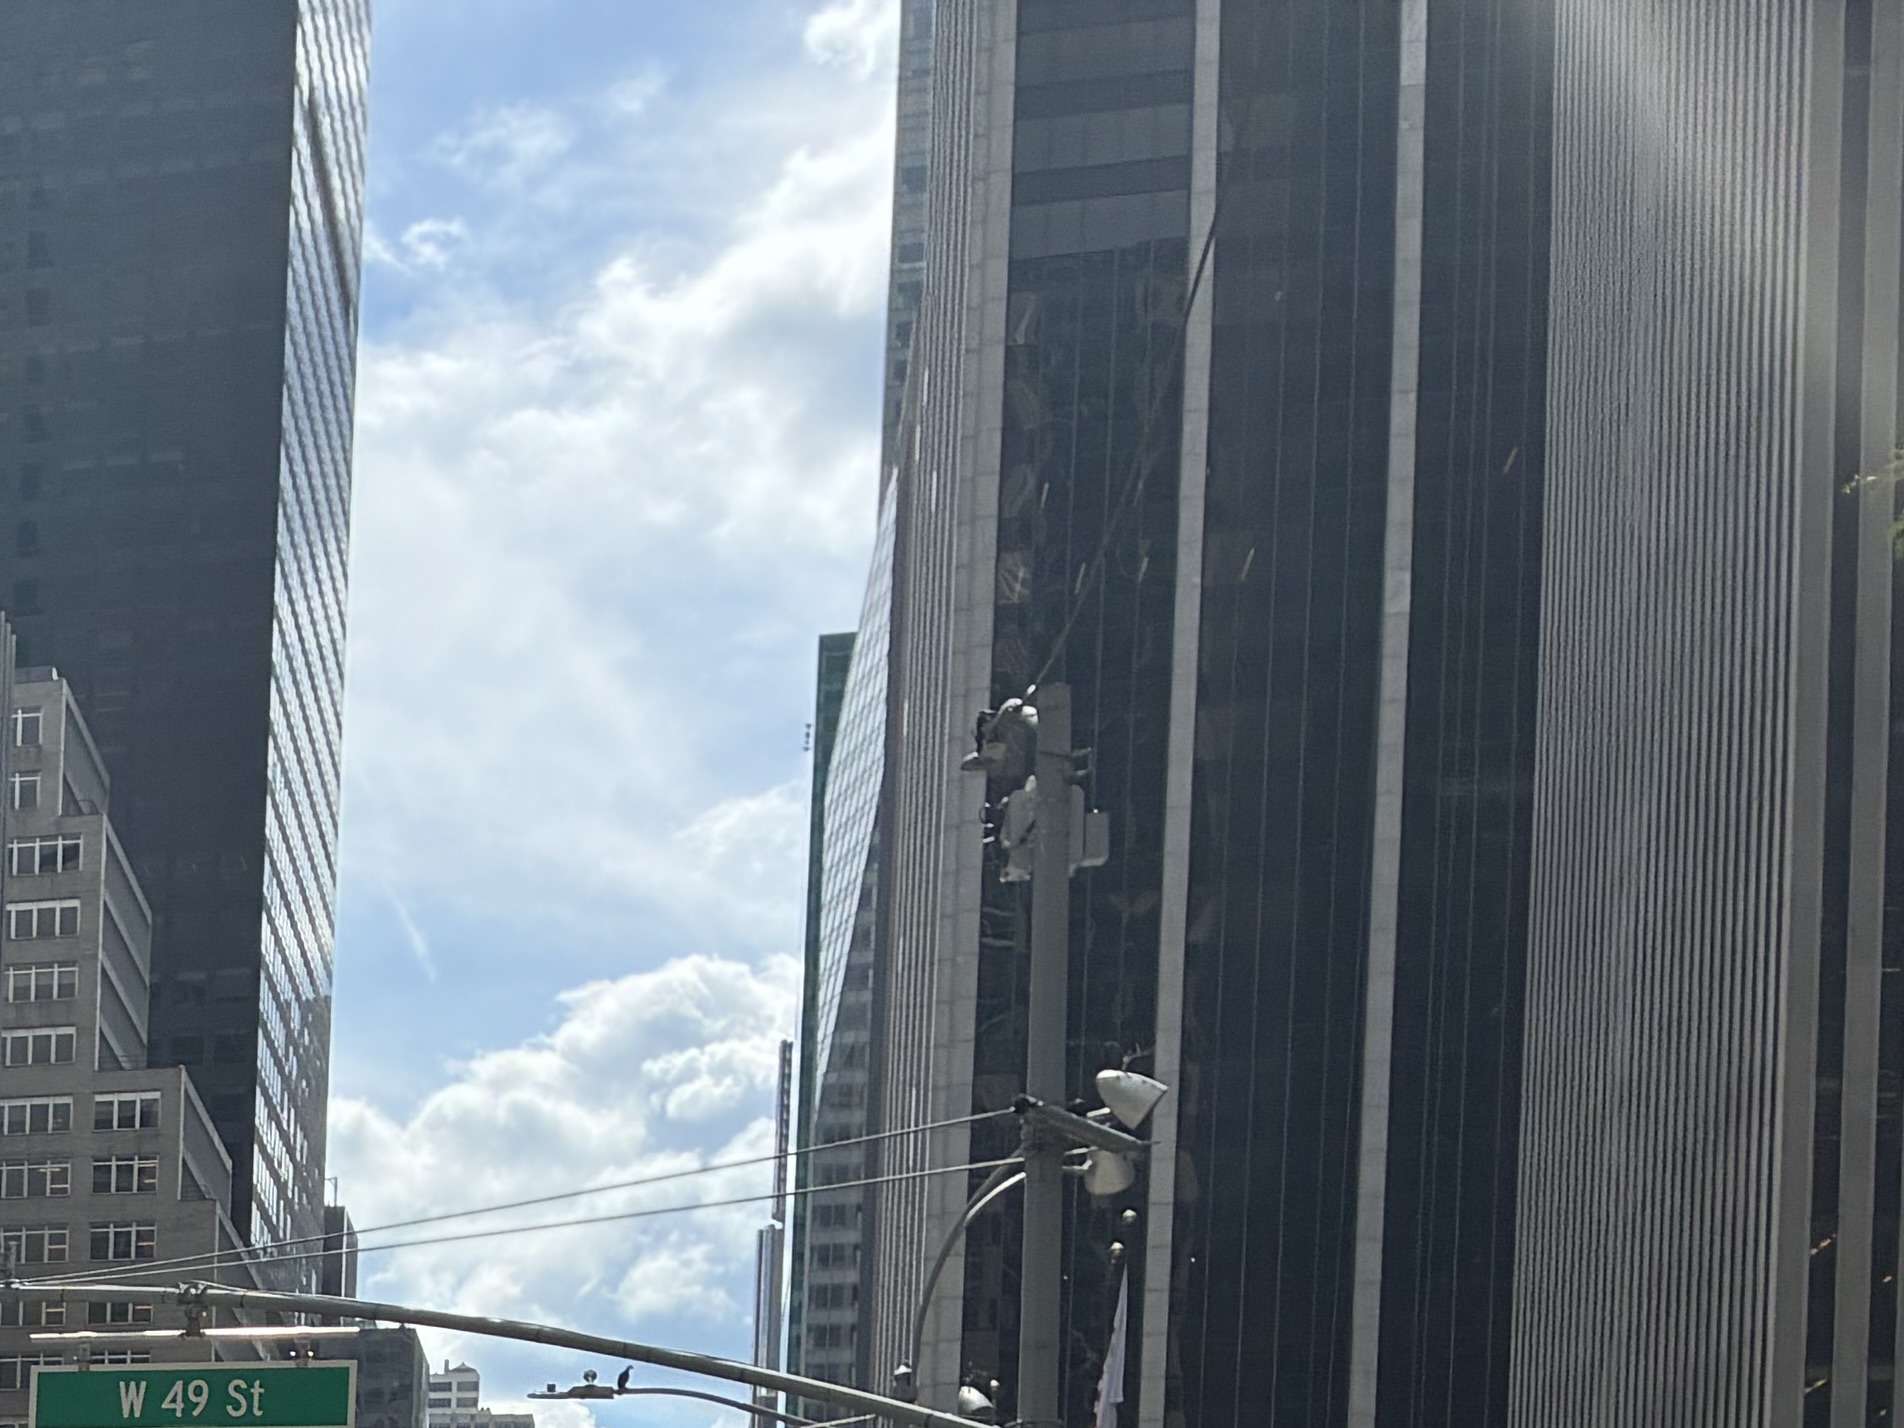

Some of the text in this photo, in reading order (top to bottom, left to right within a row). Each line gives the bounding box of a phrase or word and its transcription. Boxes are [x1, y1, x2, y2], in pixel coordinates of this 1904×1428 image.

[119, 1379, 265, 1419] W 49 St
